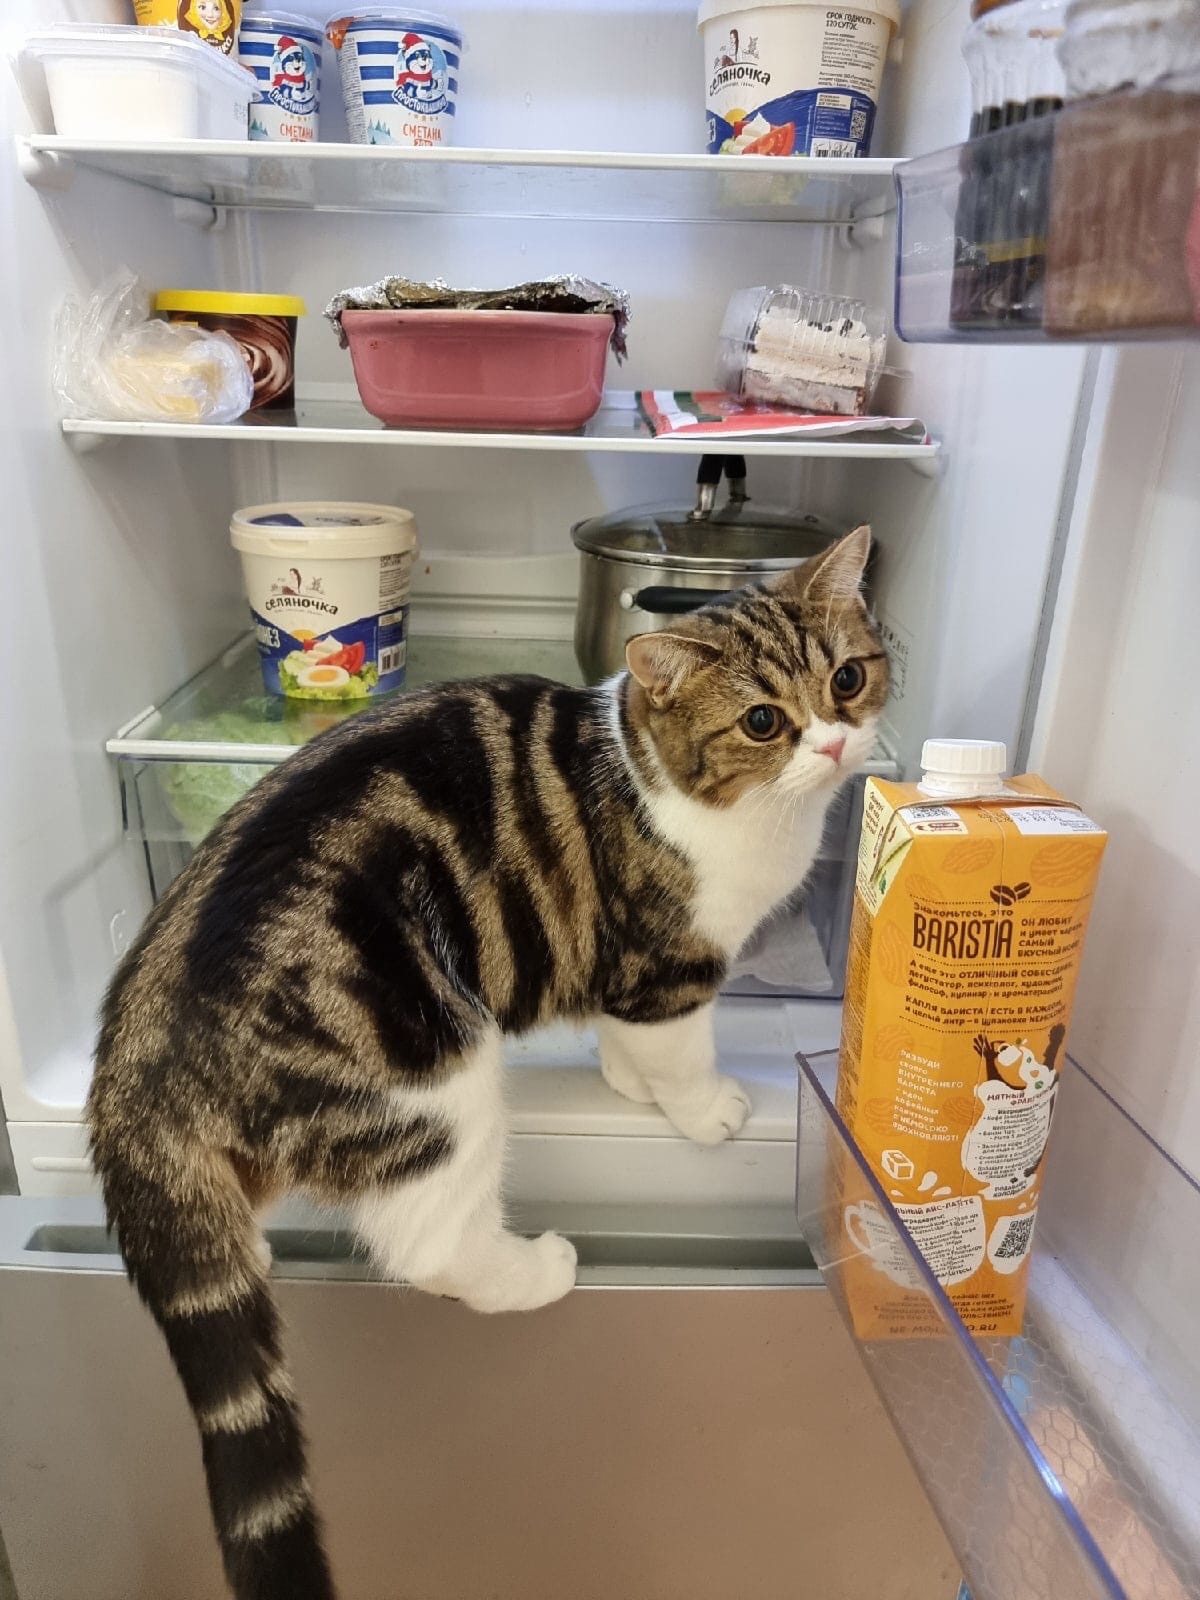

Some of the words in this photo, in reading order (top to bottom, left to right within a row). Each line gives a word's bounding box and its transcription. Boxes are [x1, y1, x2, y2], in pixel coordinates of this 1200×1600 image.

[280, 123, 314, 139] СМЕТАНА
[402, 123, 442, 141] СМЕТАНА
[913, 902, 987, 918] Знакомьтесь,
[1021, 918, 1035, 926] ОН
[1038, 916, 1072, 926] ЛЮБИТ
[912, 912, 1013, 959] BARISTA
[1029, 929, 1057, 938] умеет
[1018, 937, 1054, 947] САМЫЙ
[1017, 945, 1061, 957] ВКУСНЫЙ
[910, 959, 916, 967] А
[939, 970, 956, 979] это
[950, 991, 987, 1000] кулинар
[905, 994, 938, 1012] КАПЛЯ
[940, 1007, 984, 1015] БАРИСТА
[990, 1007, 1015, 1015] ЕСТЬ
[912, 1008, 941, 1023] целый
[943, 1018, 965, 1027] литр
[900, 1049, 940, 1069] РАЗБУДИ
[898, 1068, 964, 1089] ВНУТРЕННЕГО
[897, 1077, 937, 1097] БАРИСТА
[987, 1092, 1025, 1102] МЯТНЫЙ
[895, 1207, 924, 1215] ЛЬНЫЙ
